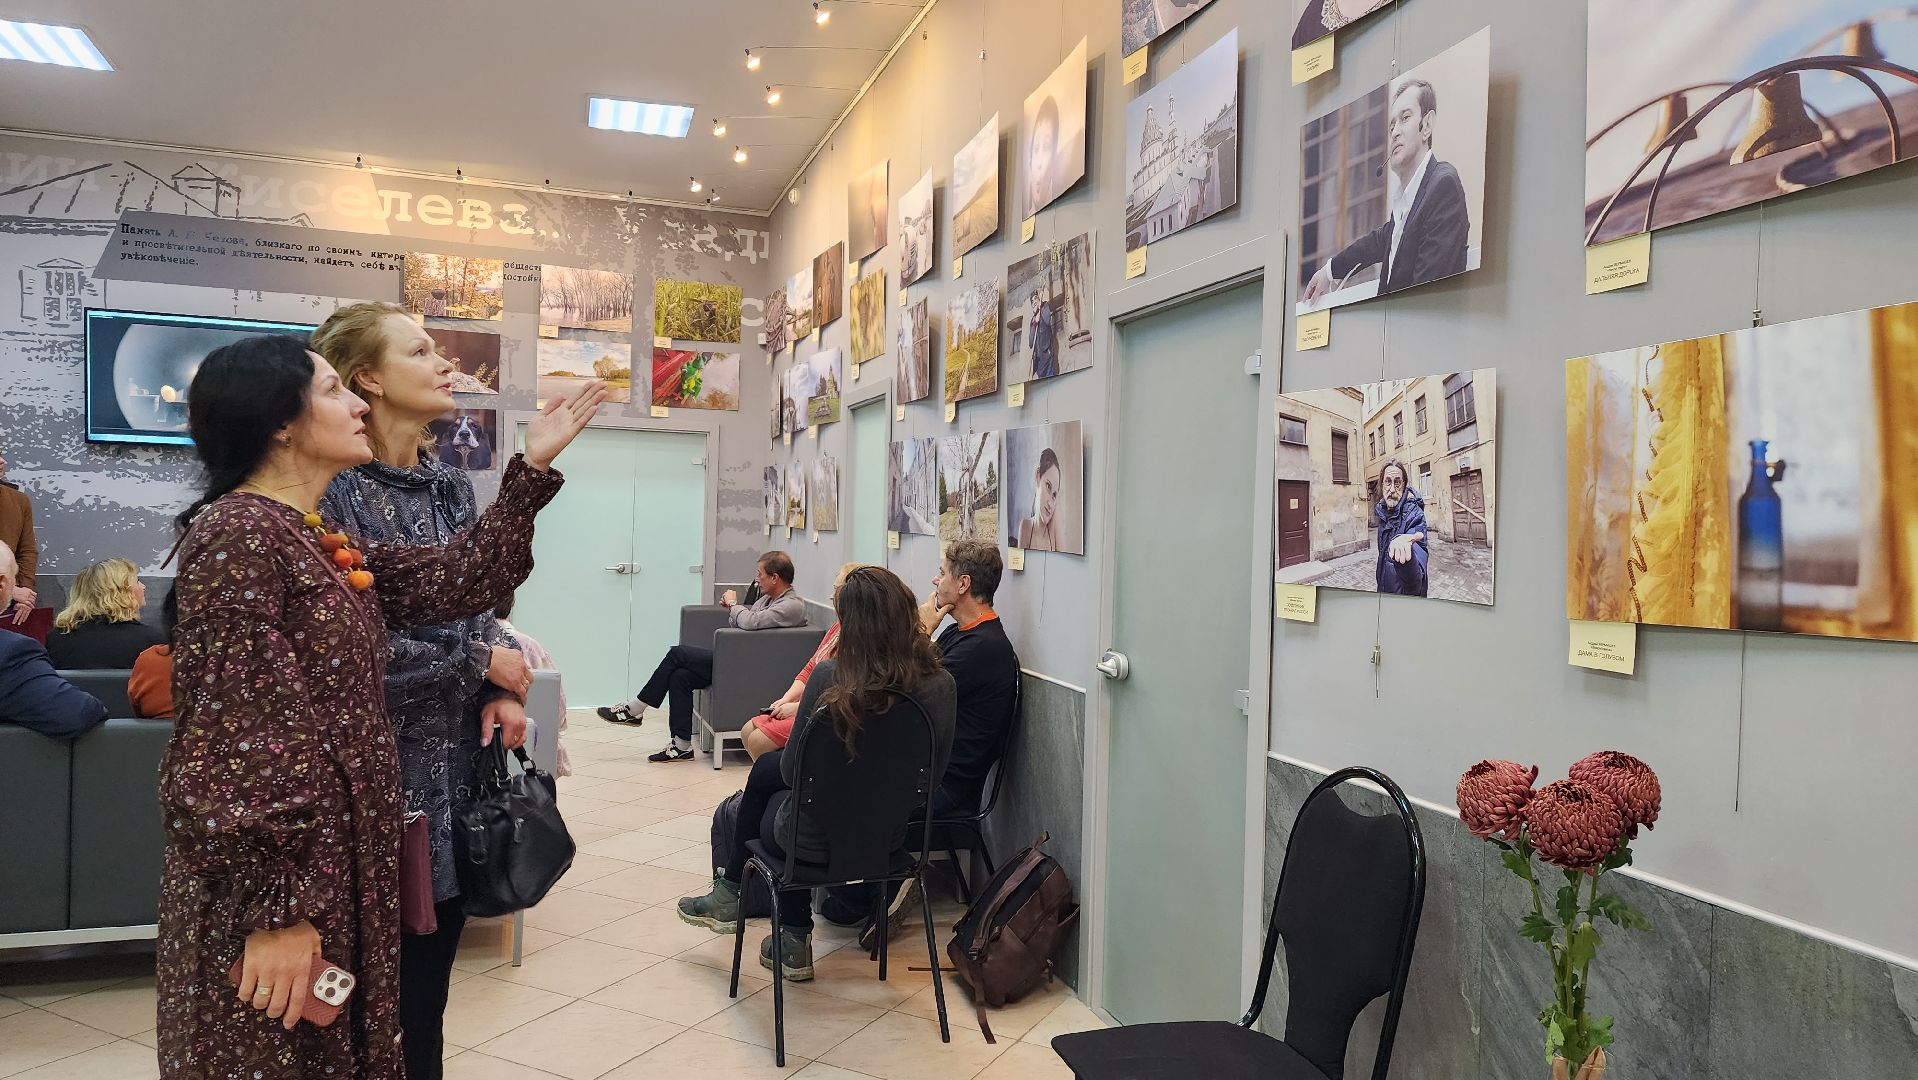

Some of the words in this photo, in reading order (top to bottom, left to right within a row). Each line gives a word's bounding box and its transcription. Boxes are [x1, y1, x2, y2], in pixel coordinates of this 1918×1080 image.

[121, 223, 160, 236] Память
[255, 239, 302, 251] близкаго
[326, 246, 362, 257] своимъ
[314, 257, 354, 268] найдетъ
[361, 261, 385, 270] себѣ
[503, 273, 541, 283] достойн
